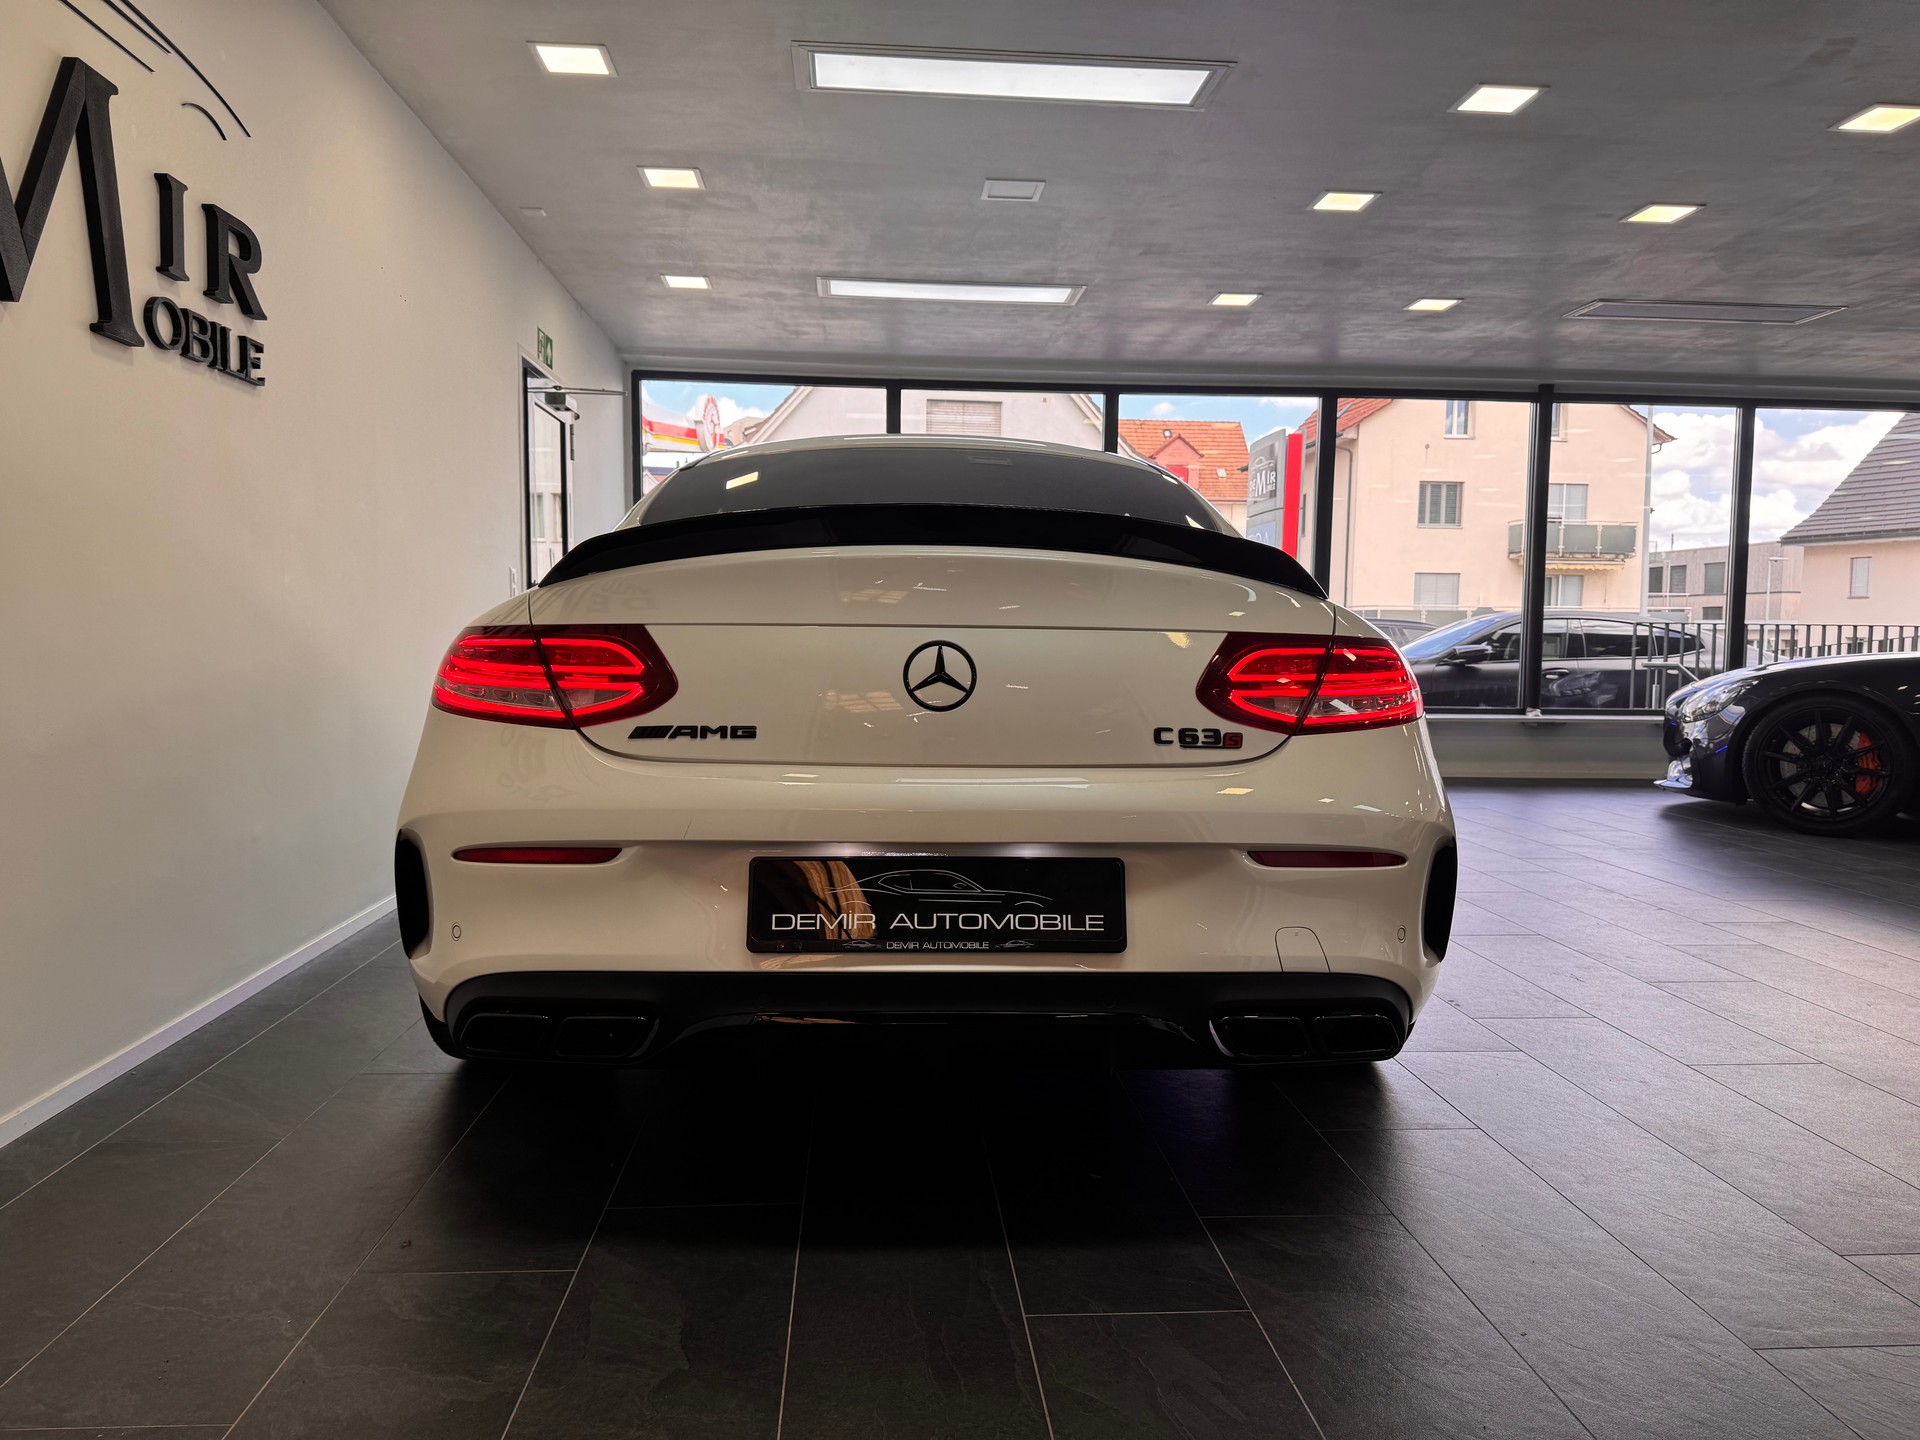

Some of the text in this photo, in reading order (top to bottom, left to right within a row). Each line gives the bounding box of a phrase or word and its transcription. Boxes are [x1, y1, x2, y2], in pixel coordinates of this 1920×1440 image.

[668, 725, 757, 739] AMG
[889, 912, 1105, 932] AUTOMOBILE
[922, 941, 990, 949] AUTOMOBILE
